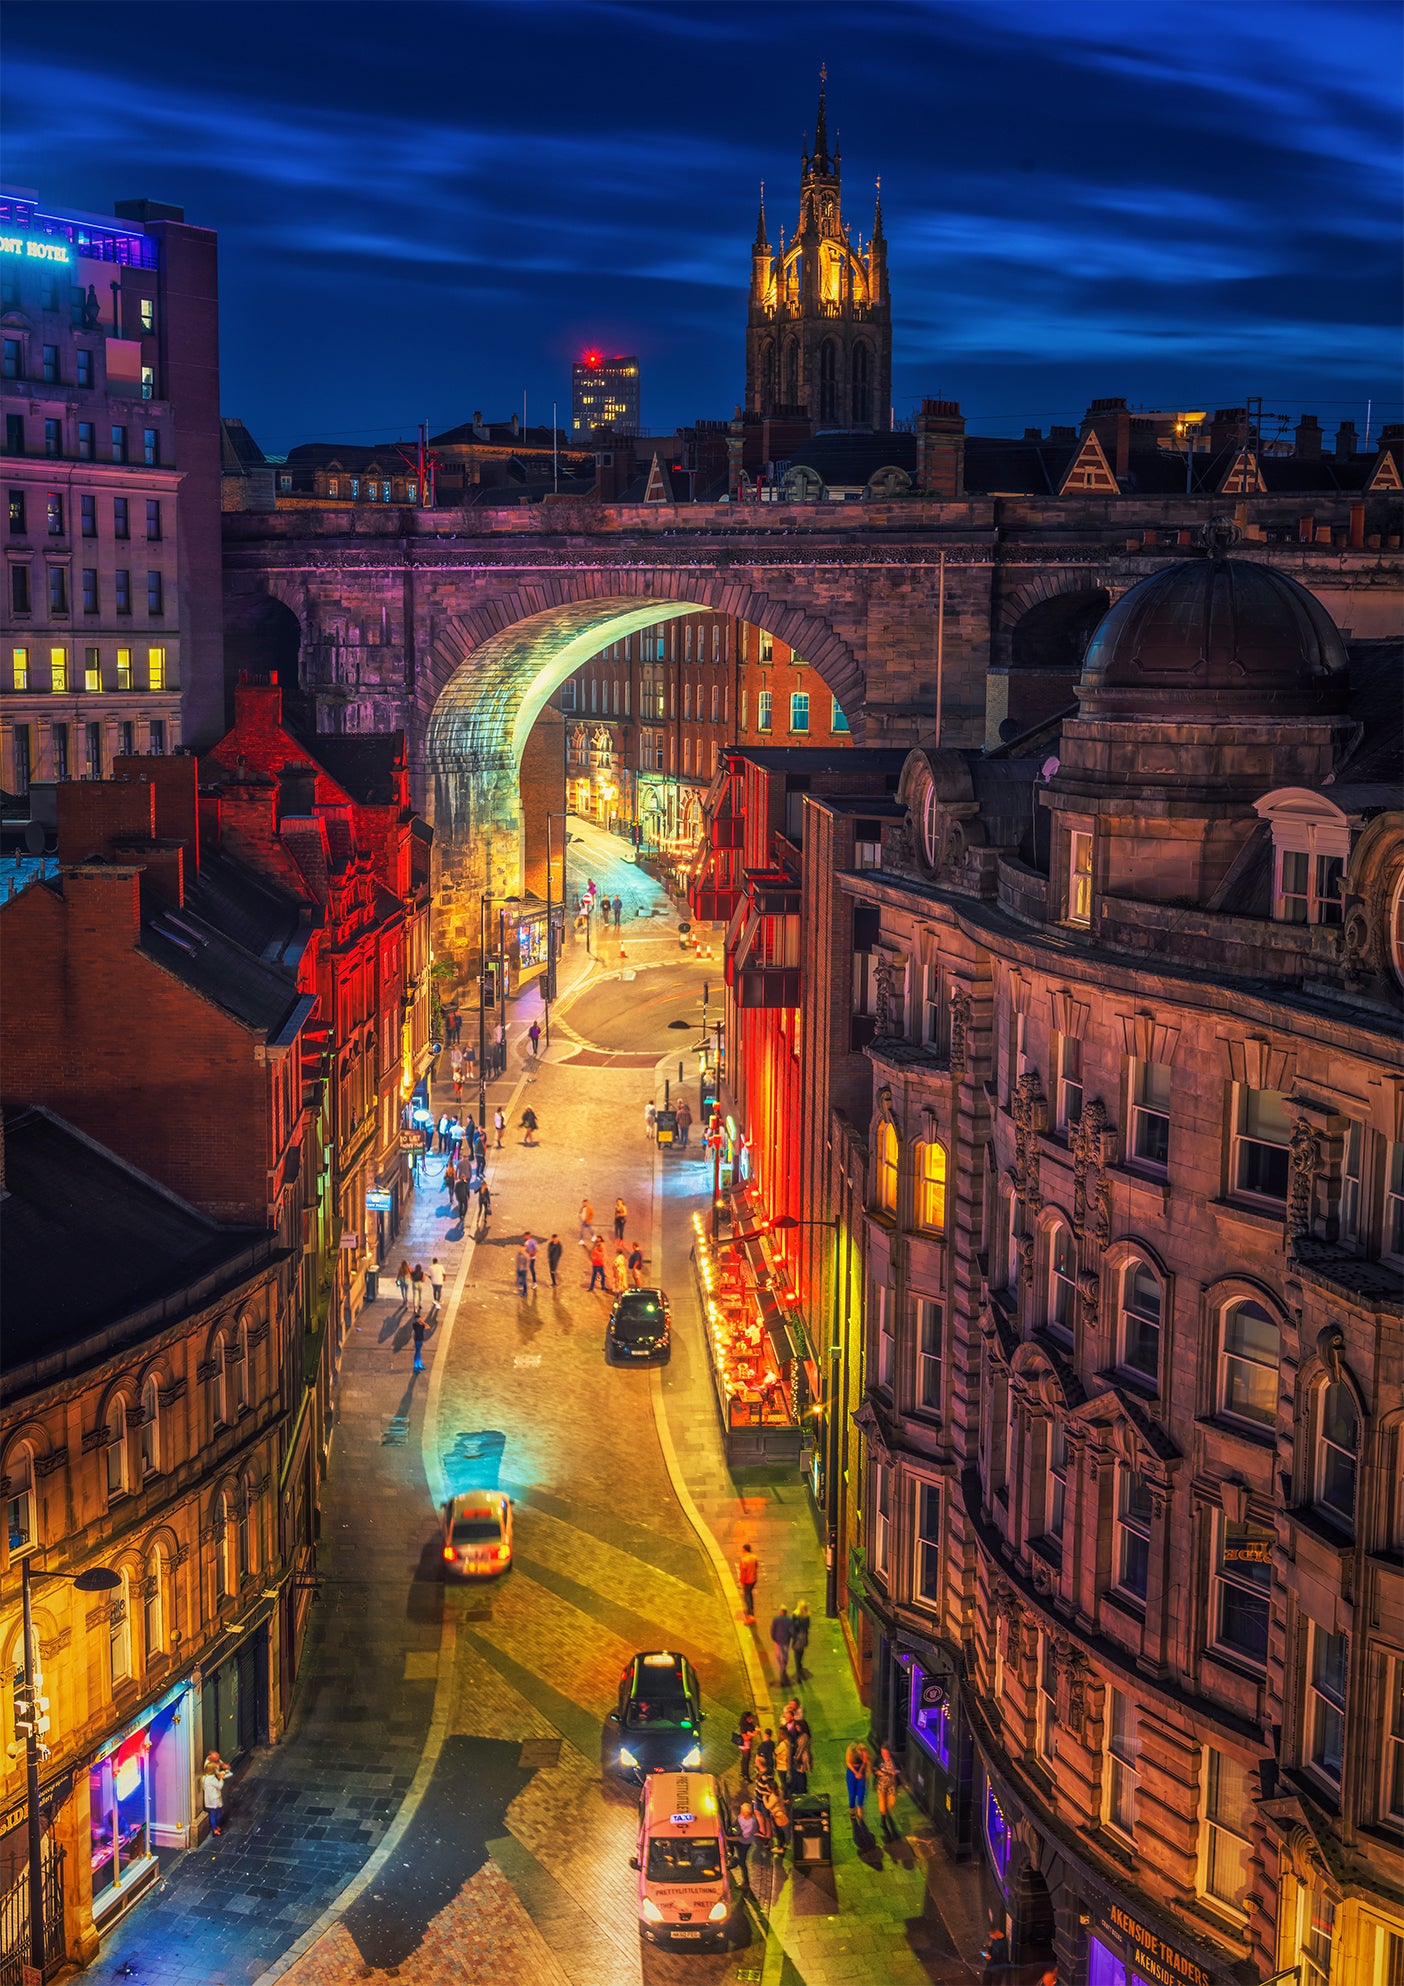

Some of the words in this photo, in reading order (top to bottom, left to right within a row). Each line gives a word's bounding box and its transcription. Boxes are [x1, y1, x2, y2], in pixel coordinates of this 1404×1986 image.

[27, 241, 69, 262] HOTEL
[672, 1814, 692, 1822] TAXI
[1110, 1905, 1158, 1955] AKENSIDE
[1160, 1942, 1209, 1986] TRADERS
